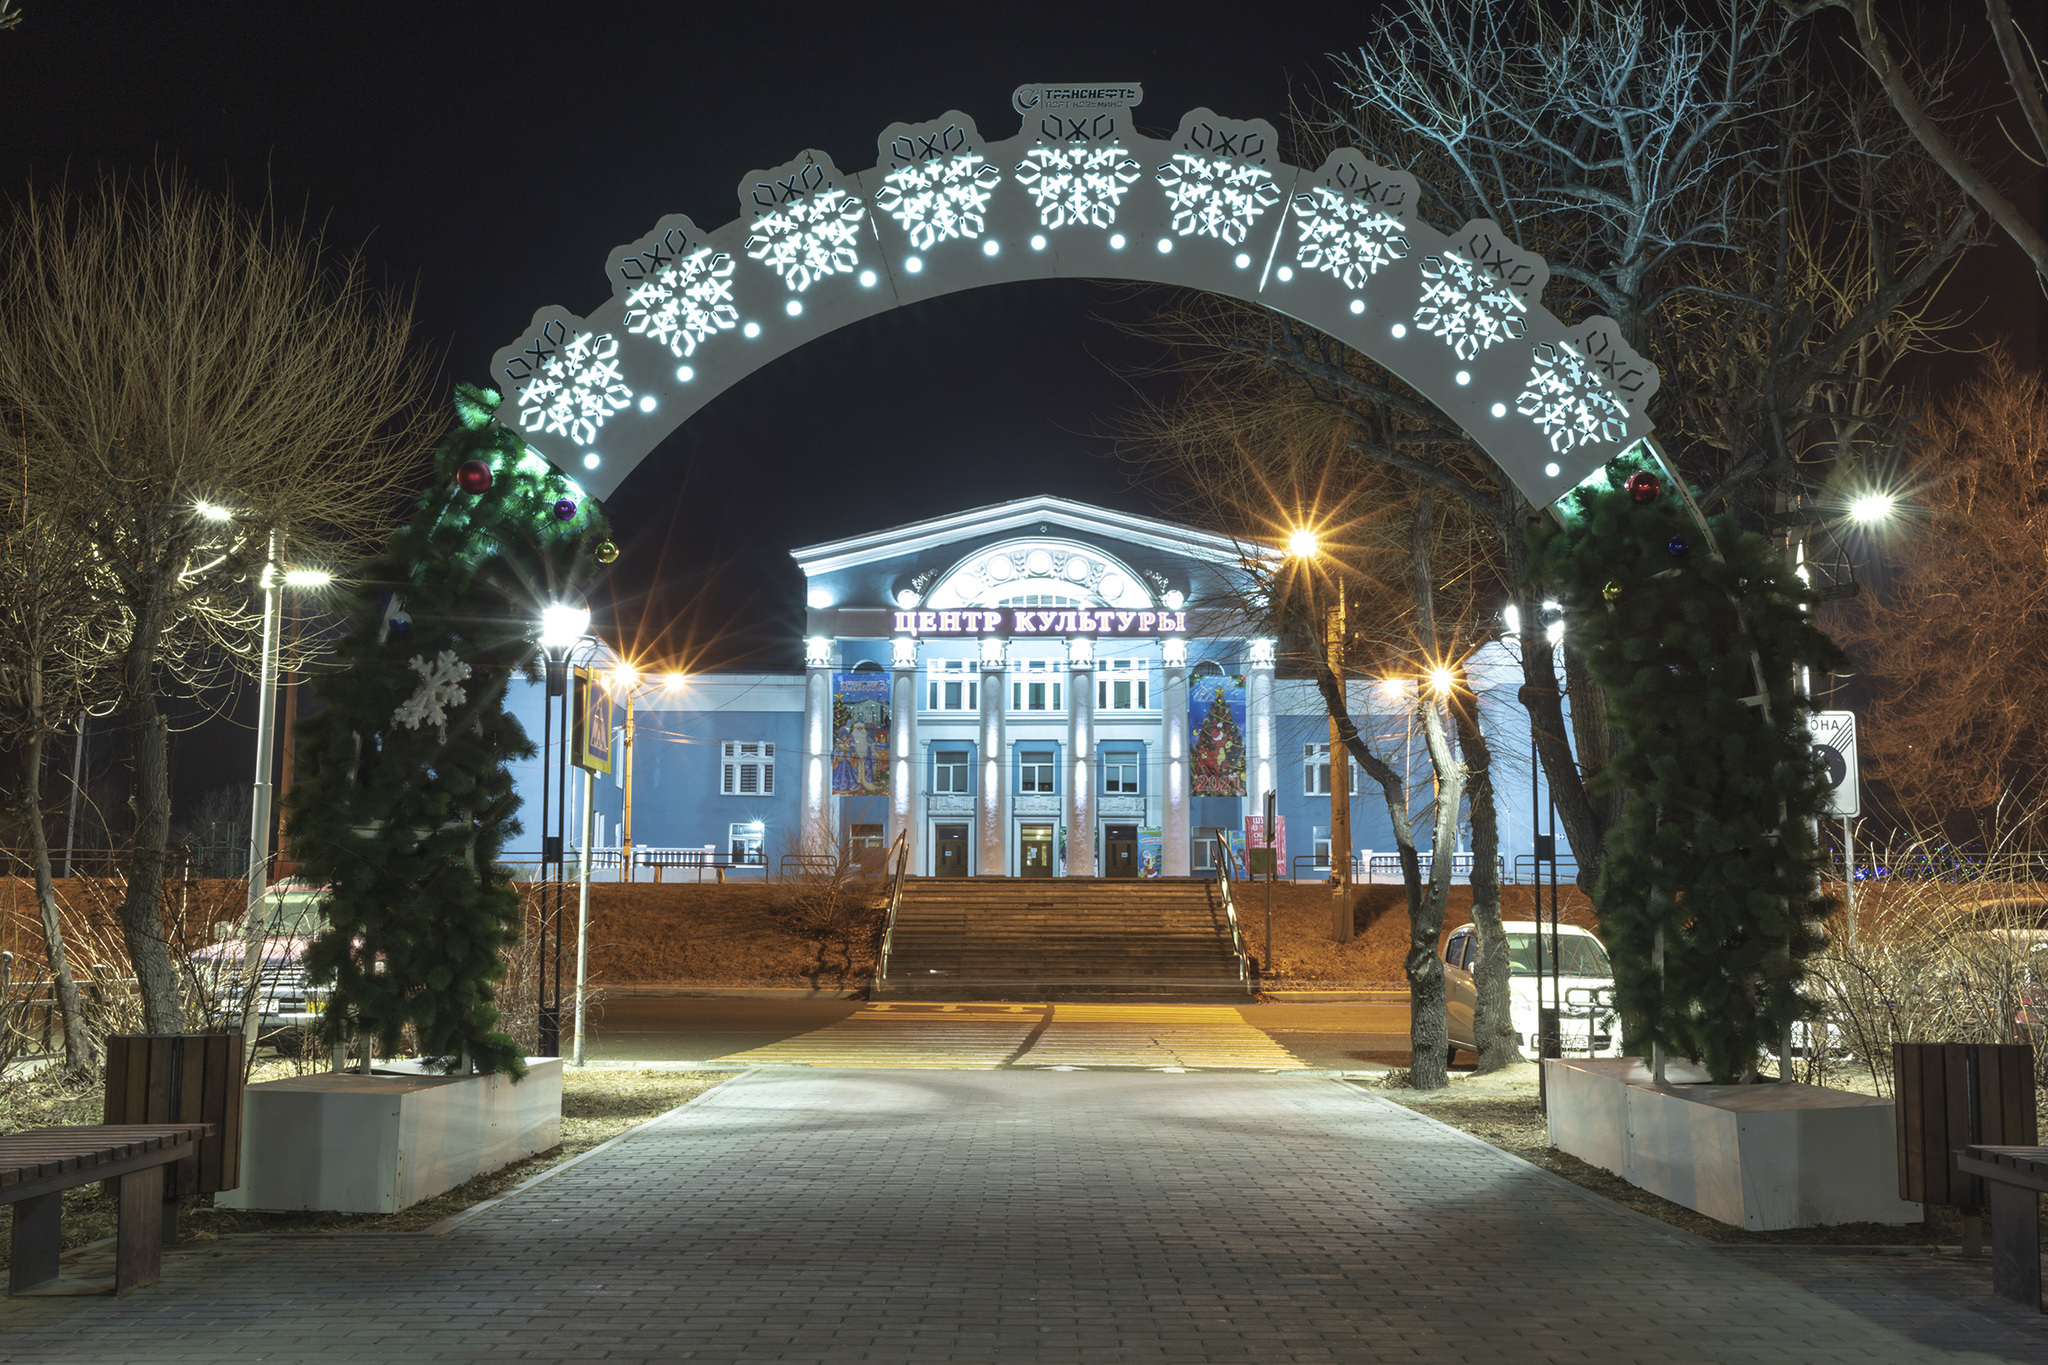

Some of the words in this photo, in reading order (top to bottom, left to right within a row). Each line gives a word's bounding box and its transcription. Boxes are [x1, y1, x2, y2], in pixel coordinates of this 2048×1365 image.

[1045, 88, 1135, 99] ТРАНСНЕФТЬ
[1045, 101, 1070, 109] ПОРТ
[1072, 101, 1123, 109] КОЗЬМИНО
[894, 611, 1002, 637] ЦЕНТР
[1014, 611, 1187, 632] КУЛЬТУРЫ
[1810, 719, 1840, 731] ОНА
[1198, 774, 1240, 791] 2021
